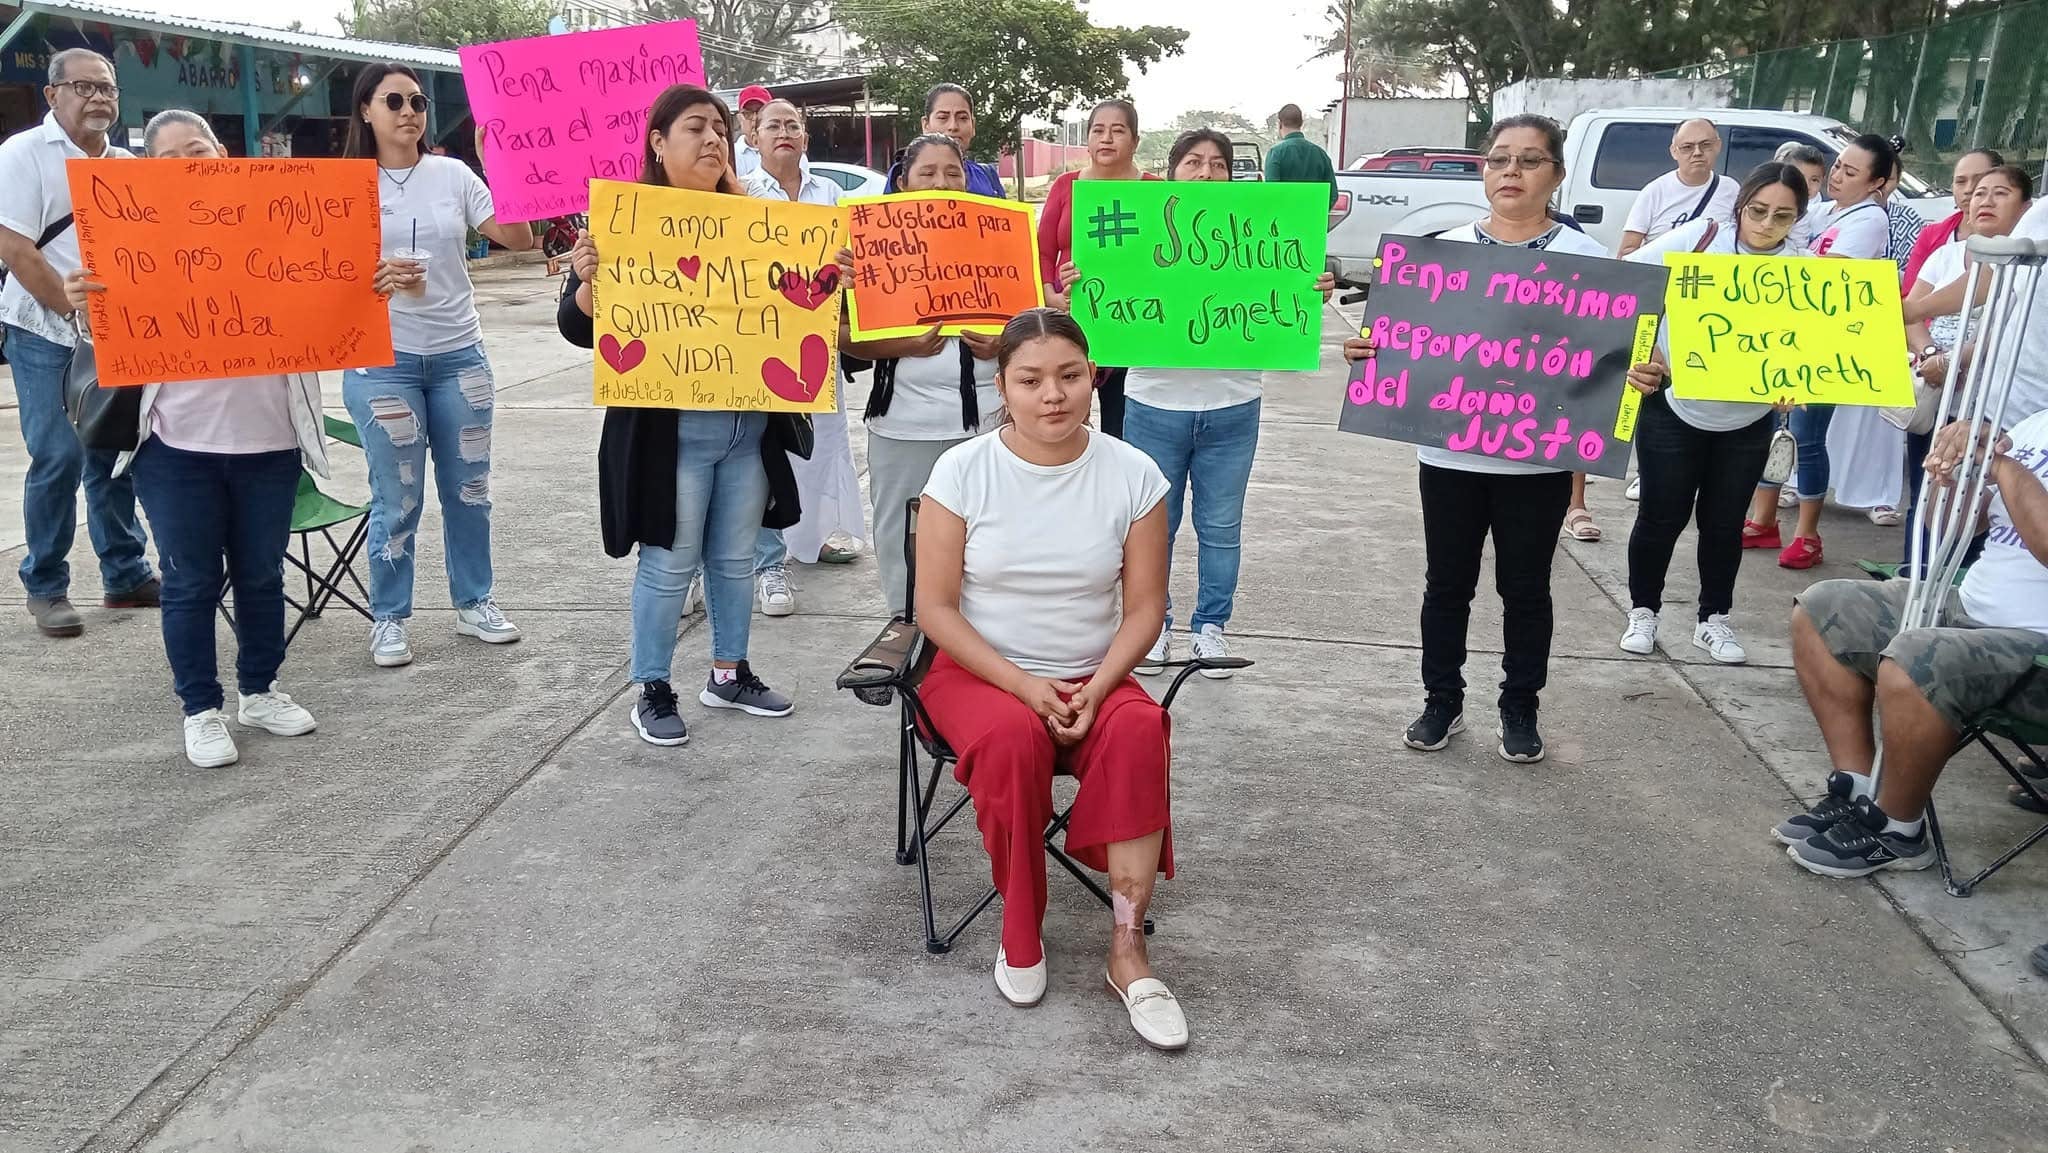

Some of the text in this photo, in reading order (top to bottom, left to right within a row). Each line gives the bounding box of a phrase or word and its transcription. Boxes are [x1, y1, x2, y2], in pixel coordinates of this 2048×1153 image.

[178, 63, 261, 92] ABARROS
[479, 44, 696, 102] Pena maxima
[568, 107, 592, 142] el
[606, 107, 653, 145] agre
[250, 162, 275, 178] para
[525, 161, 562, 185] de
[92, 174, 161, 222] Que
[609, 192, 839, 265] El amor de mi
[851, 200, 1011, 239] #Justicia para
[853, 228, 929, 261] Janeth
[114, 247, 157, 284] no
[174, 246, 222, 283] nos
[706, 255, 761, 305] ME
[1380, 241, 1469, 303] Pena
[914, 280, 1001, 317] Janeth
[1082, 278, 1309, 345] Para Janeth
[611, 302, 780, 340] QUITAR LA
[1698, 312, 1801, 354] Para
[223, 356, 256, 376] para
[1371, 316, 1594, 378] Reparación
[1348, 357, 1536, 417] del daño
[1750, 353, 1882, 396] Janeth
